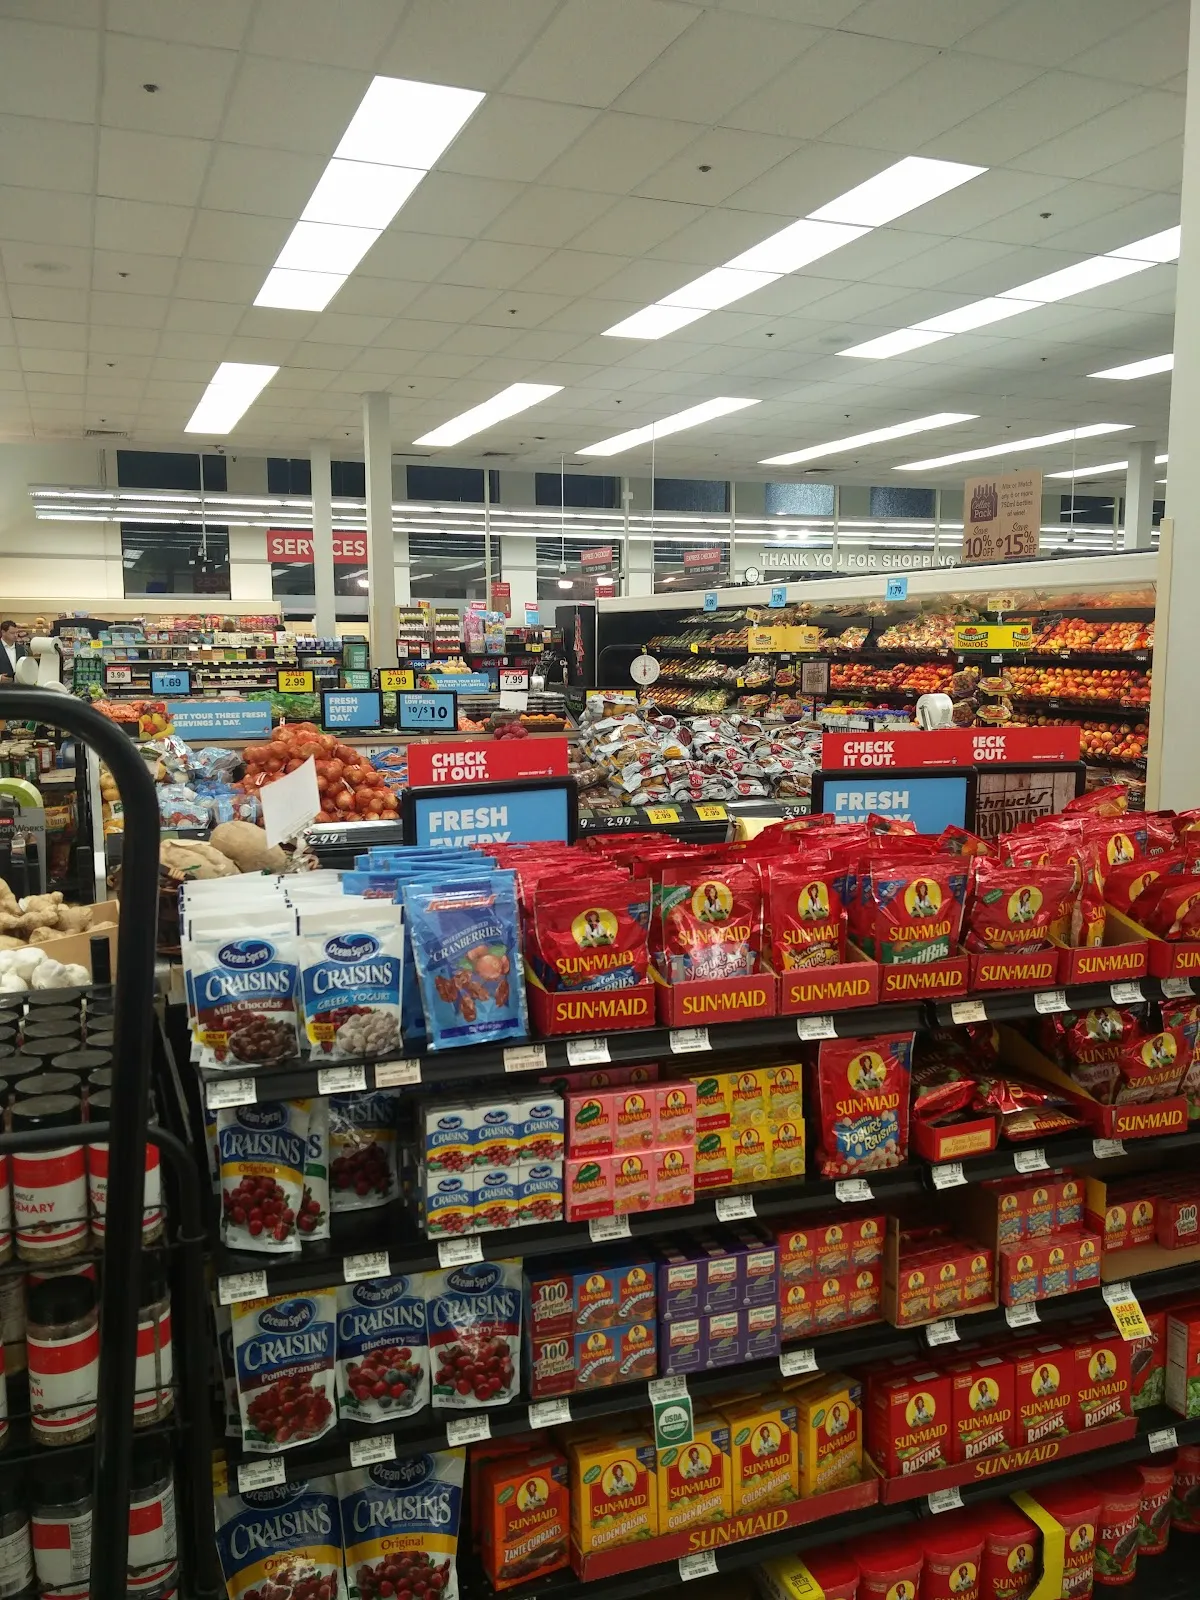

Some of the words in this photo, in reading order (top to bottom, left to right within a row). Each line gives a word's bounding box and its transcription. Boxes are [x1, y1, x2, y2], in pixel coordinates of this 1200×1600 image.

[974, 509, 992, 519] Pack
[1012, 522, 1028, 533] Save
[272, 538, 366, 556] SERCES
[983, 548, 994, 556] OFF
[1023, 544, 1036, 554] OFF
[760, 554, 808, 566] THANK
[848, 554, 876, 567] FOR
[958, 640, 988, 648] TOMATOES
[110, 672, 126, 680] 3.99
[160, 678, 182, 688] 1.69
[285, 678, 306, 686] 2.99
[387, 677, 407, 686] 2.99
[504, 676, 523, 685] 7.99
[329, 697, 358, 705] FRESH
[329, 706, 358, 714] EVERY
[330, 714, 351, 722] DAY.
[843, 741, 895, 754] CHECK
[974, 748, 1007, 761] OUT.
[432, 751, 487, 767] CHECK
[844, 755, 856, 766] IT
[860, 754, 896, 766] OUT.
[432, 768, 448, 781] IT
[451, 766, 490, 780] OUT.
[835, 791, 909, 810] FRESH
[428, 806, 508, 833] FRESH
[309, 834, 338, 844] 2.99
[328, 943, 351, 958] Ocean
[350, 941, 374, 957] Spray
[433, 926, 502, 962] CRANBERRIES
[222, 949, 245, 964] Ocean
[246, 948, 268, 964] Spray
[206, 969, 290, 1001] CRAISINS
[313, 962, 393, 994] CRAISINS
[600, 974, 616, 986] Cod
[317, 998, 349, 1010] GREEK
[352, 992, 392, 1003] YOGURT
[214, 1004, 235, 1016] Milk
[524, 1120, 559, 1134] CRAISINS
[850, 1116, 872, 1130] Vanilla
[432, 1130, 469, 1146] CRAISINS
[478, 1125, 515, 1140] CRAISINS
[843, 1117, 882, 1152] Yogurt
[864, 1120, 898, 1150] Raisins
[222, 1132, 300, 1165] CRAISINS
[238, 1163, 276, 1174] Original
[478, 1186, 514, 1201] CRAISINS
[524, 1180, 558, 1194] CRAISINS
[432, 1193, 469, 1208] CRAISINS
[1180, 1206, 1196, 1221] 100
[450, 1274, 474, 1288] Ocean
[474, 1272, 496, 1288] Spray
[356, 1286, 381, 1300] Ocean
[381, 1280, 403, 1298] Spray
[541, 1284, 566, 1301] 100
[433, 1288, 516, 1327] CRAISINS
[577, 1298, 614, 1324] Cranberries
[618, 1291, 654, 1317] Cranberries
[1116, 1303, 1135, 1314] SALE!
[262, 1312, 288, 1327] Ocean
[288, 1306, 310, 1327] Spray
[339, 1302, 425, 1341] CRAISINS
[1120, 1314, 1142, 1328] FREE
[244, 1326, 328, 1371] CRAISINS
[360, 1336, 405, 1351] Blueberry
[543, 1342, 567, 1360] 100
[620, 1346, 656, 1374] Cranberries
[261, 1362, 322, 1382] Pomegranate
[578, 1355, 616, 1384] Cranberries
[664, 1413, 682, 1423] USDA
[1085, 1401, 1121, 1428] RAISINS
[1027, 1415, 1064, 1443] RAISINS
[965, 1431, 1004, 1460] RAISINS
[817, 1466, 838, 1484] GOLDEN
[836, 1450, 856, 1470] RAISINS
[902, 1446, 941, 1475] RAISINS
[374, 1464, 399, 1480] Ocean
[400, 1460, 426, 1481] Spray
[741, 1487, 767, 1505] GOLDEN
[767, 1472, 791, 1492] RAISINS
[353, 1492, 451, 1532] CRAISINS
[668, 1507, 696, 1528] GOLDEN
[696, 1494, 722, 1516] RAISINS
[230, 1503, 332, 1560] CRAISINS
[591, 1526, 620, 1547] GOLDEN
[620, 1513, 648, 1534] RAISINS
[381, 1537, 424, 1550] Original
[504, 1544, 527, 1563] ZANTE
[527, 1524, 562, 1553] CURRANTS
